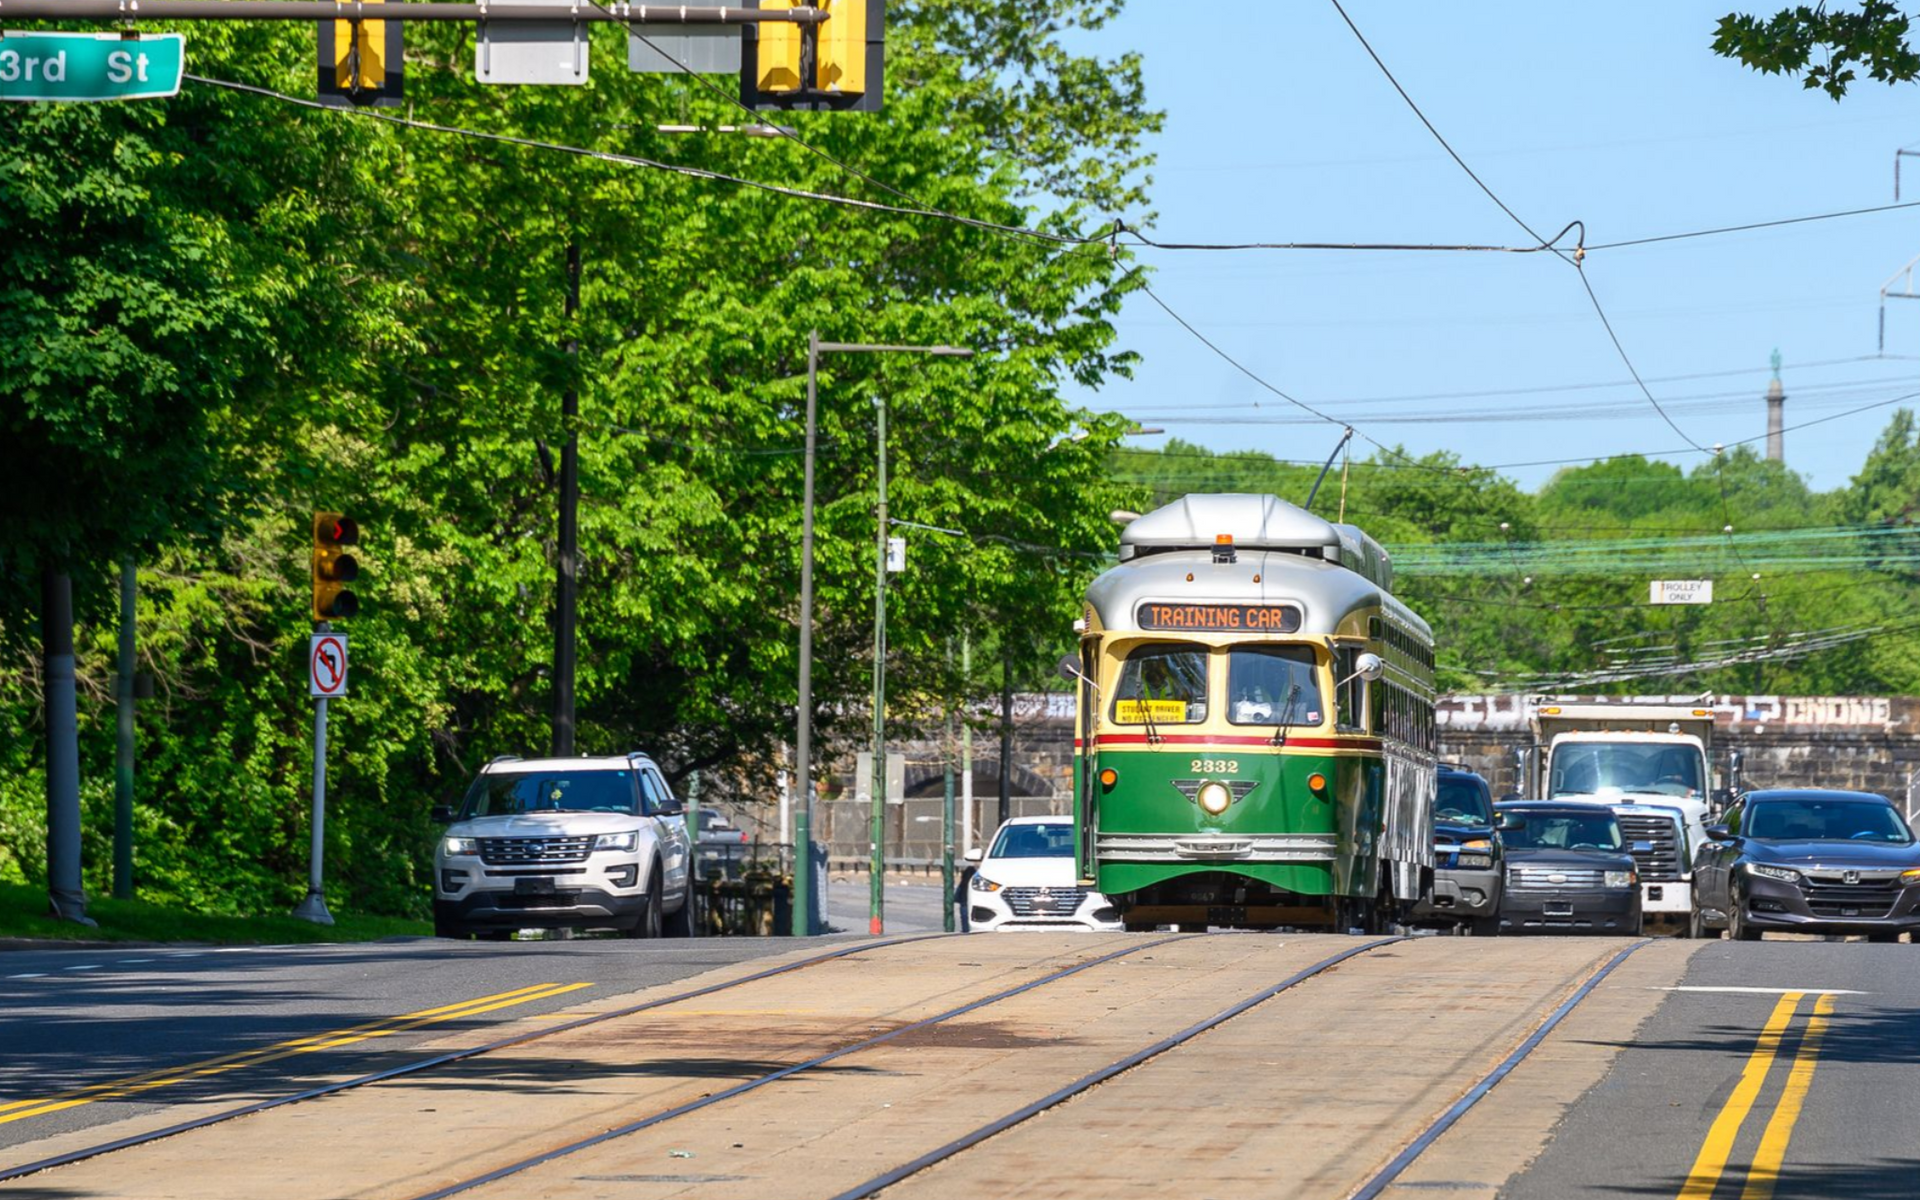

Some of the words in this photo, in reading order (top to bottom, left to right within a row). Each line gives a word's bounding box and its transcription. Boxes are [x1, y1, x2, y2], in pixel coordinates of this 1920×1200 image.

[0, 50, 66, 82] 3rd
[107, 51, 149, 83] St
[1660, 582, 1702, 592] TROLLEY
[1669, 592, 1693, 602] ONLY
[1151, 606, 1240, 628] TRAINING
[1246, 608, 1282, 629] CAR
[1155, 705, 1181, 714] DRIVER
[1134, 715, 1180, 723] PAENGERS
[1191, 759, 1239, 774] 2332
